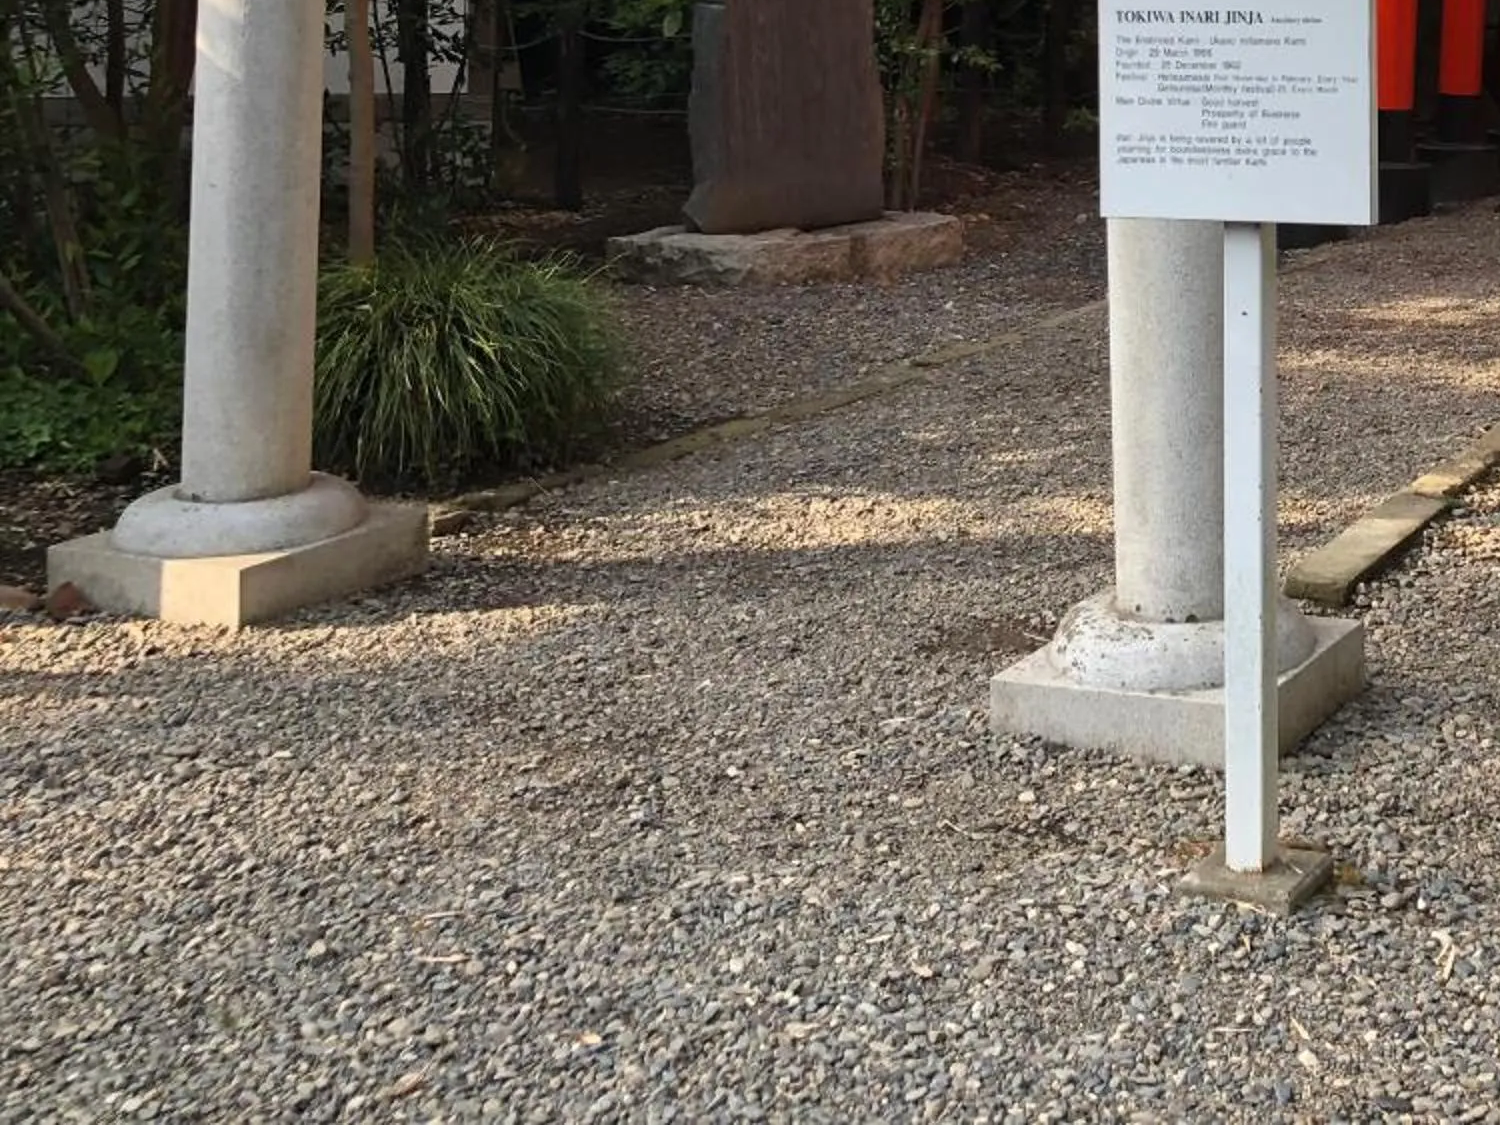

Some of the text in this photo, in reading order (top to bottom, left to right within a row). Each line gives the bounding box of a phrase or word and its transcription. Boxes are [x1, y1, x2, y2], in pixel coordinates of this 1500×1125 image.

[1116, 10, 1175, 24] TOKIWA
[1180, 10, 1219, 24] INARI
[1225, 10, 1263, 26] JINJA
